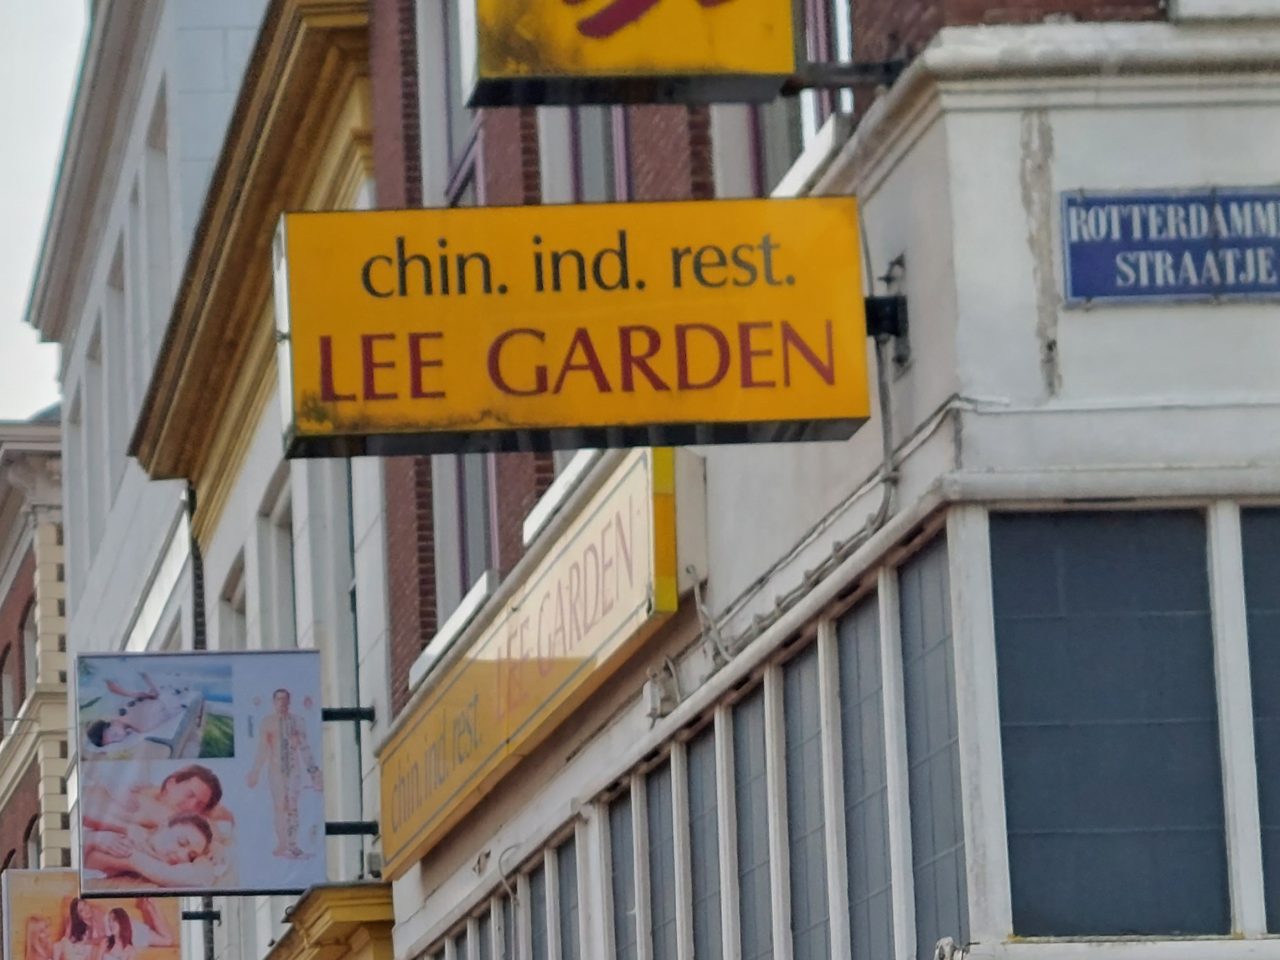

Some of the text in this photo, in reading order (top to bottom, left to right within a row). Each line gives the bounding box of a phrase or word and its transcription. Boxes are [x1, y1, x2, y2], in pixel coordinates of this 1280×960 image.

[1069, 201, 1280, 242] ROTTERDAMM
[361, 229, 796, 298] chin. ind. rest.
[1115, 246, 1277, 287] STRAATJE
[320, 319, 836, 401] LEE GARDEN
[537, 494, 634, 678] GARDEN
